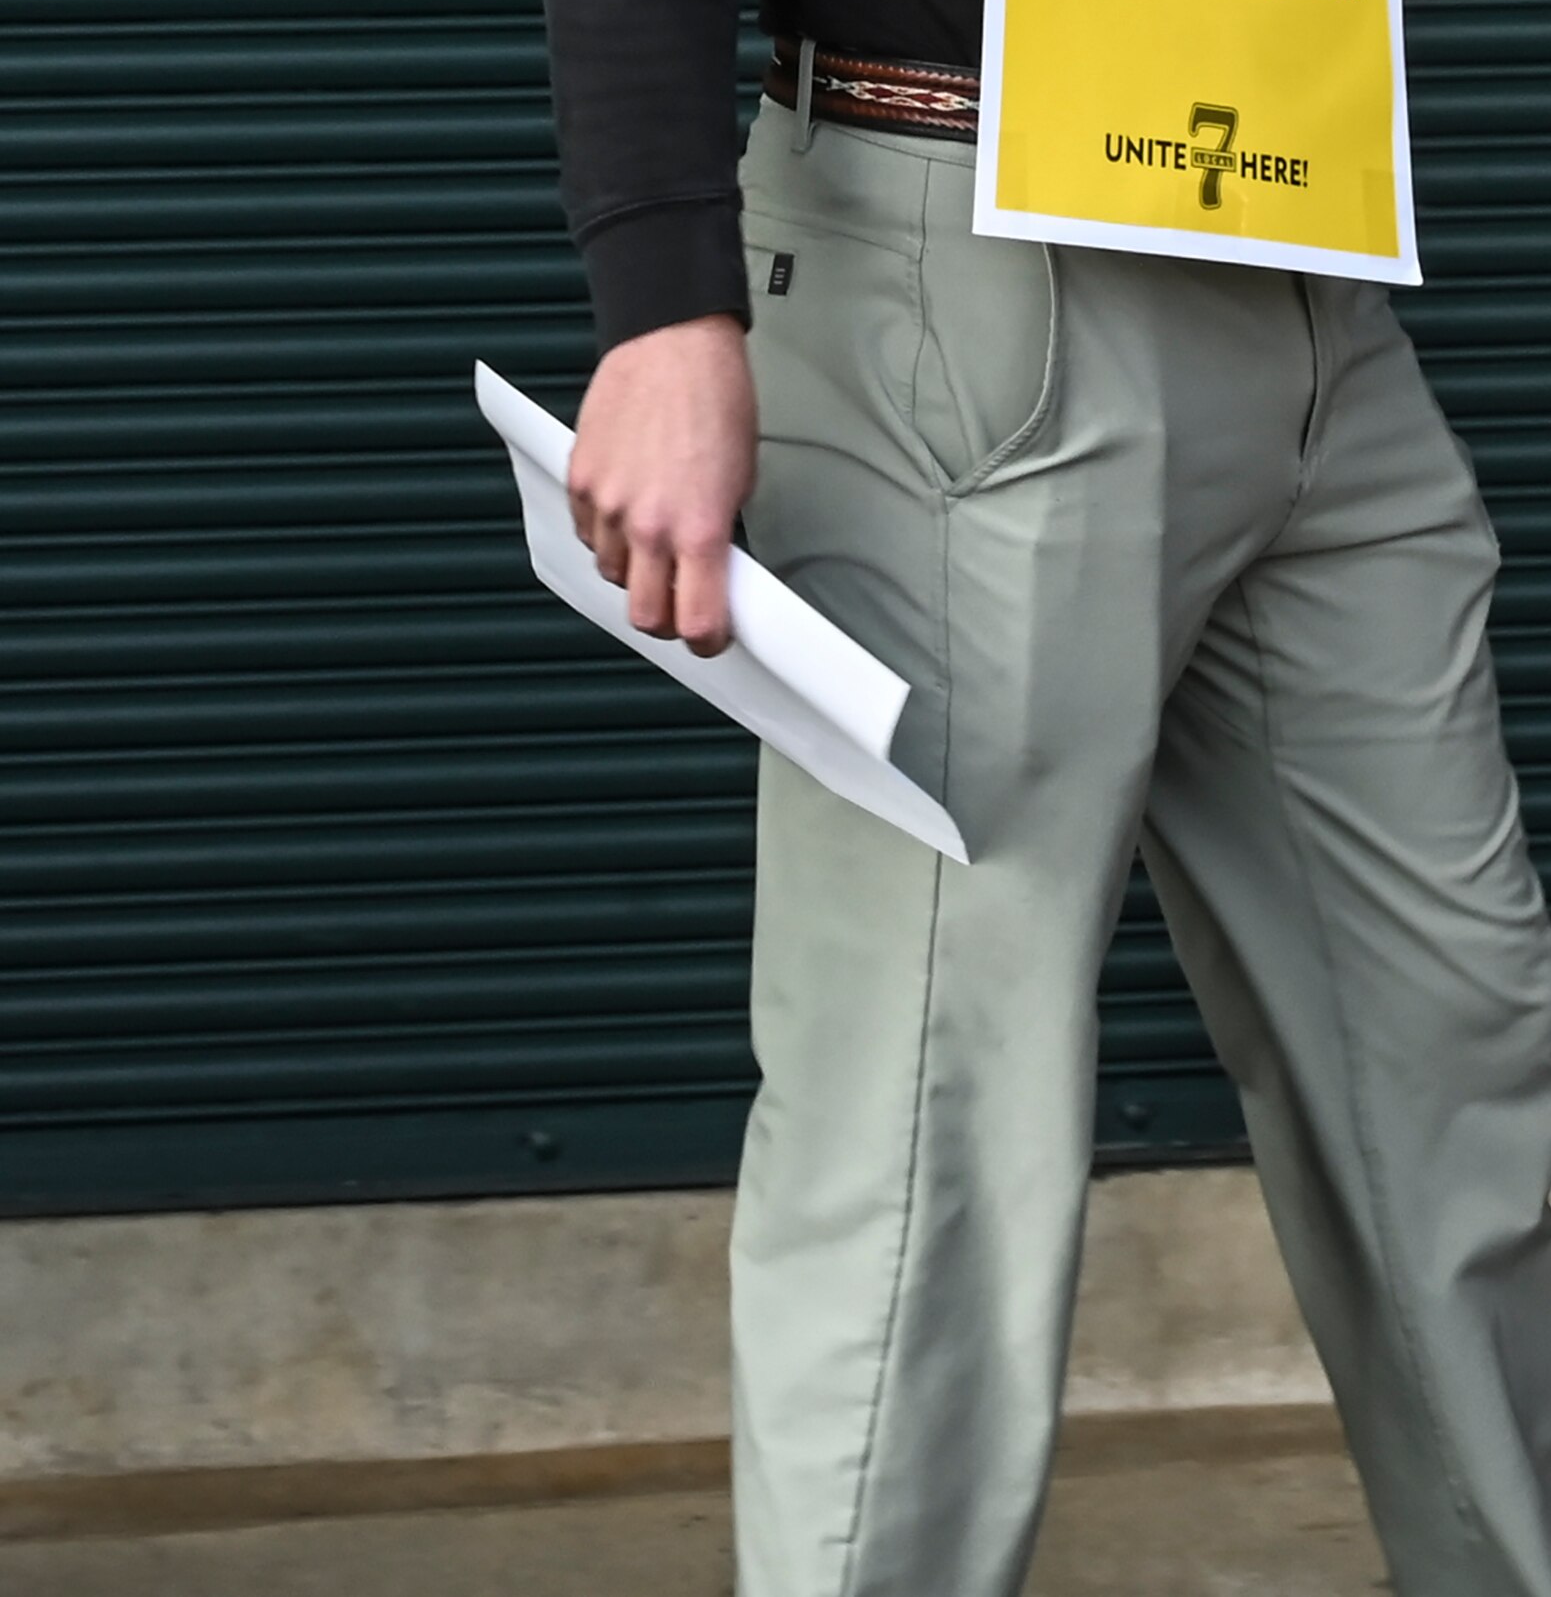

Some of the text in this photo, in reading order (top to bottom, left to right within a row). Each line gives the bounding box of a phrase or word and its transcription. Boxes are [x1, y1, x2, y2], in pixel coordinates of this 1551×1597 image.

[1105, 101, 1308, 210] UNITE 7 HERE!
[1195, 151, 1234, 169] LOCAL
